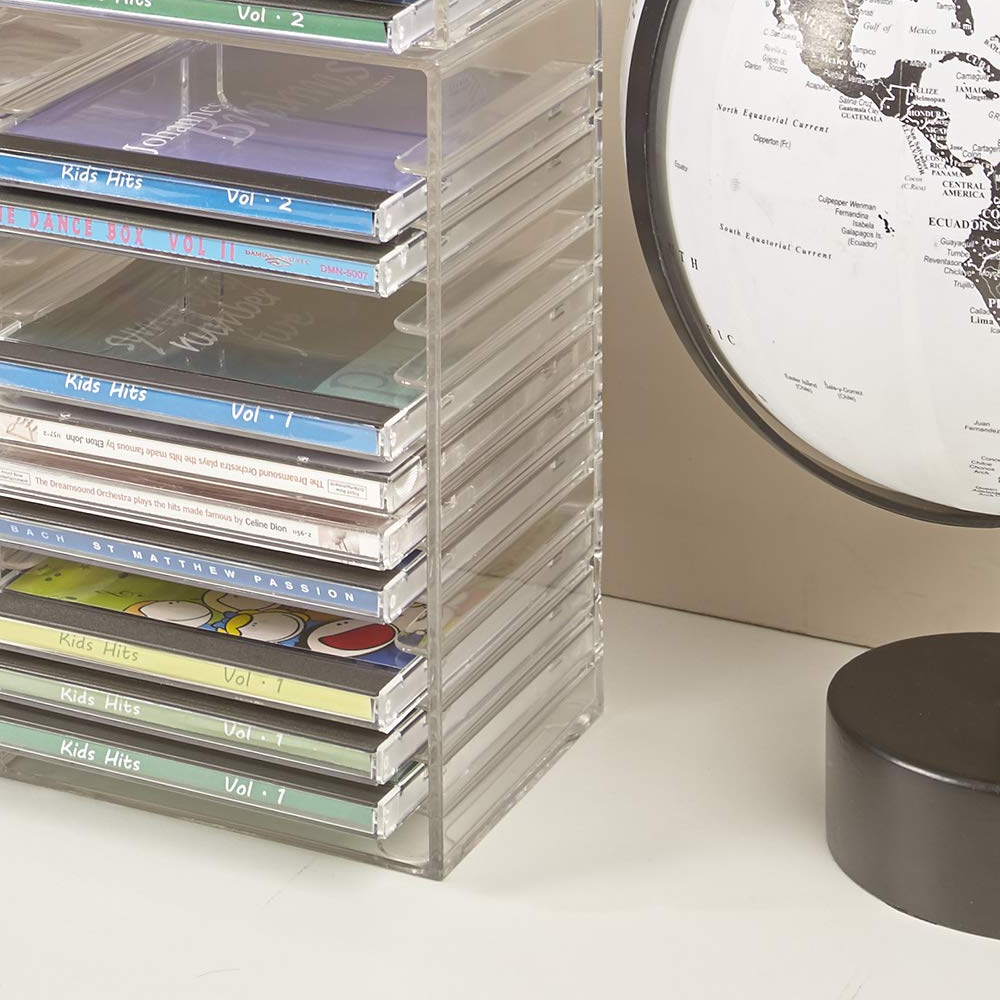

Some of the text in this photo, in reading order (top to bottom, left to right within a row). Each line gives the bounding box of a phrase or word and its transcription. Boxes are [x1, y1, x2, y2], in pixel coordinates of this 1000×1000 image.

[237, 5, 266, 24] Vol
[291, 11, 305, 28] 2
[862, 22, 937, 36] Gulf of Mexico
[716, 103, 830, 135] North Equatorial Current
[62, 164, 293, 213] Kids Hits Vol 2
[942, 179, 986, 191] CENTRAL
[942, 189, 986, 200] AMERICA
[928, 216, 988, 232] ECUADOR
[29, 210, 92, 237] DANCE
[108, 222, 145, 246] BOX
[168, 232, 206, 257] VOL
[320, 264, 369, 280] DMN-5007
[719, 223, 833, 261] South Equatorial Current
[970, 316, 994, 326] Lima
[65, 372, 294, 429] Kids Hits Vol 1
[10, 523, 356, 602] BACH ST MATTHEW PASSION
[60, 740, 286, 805] Kids Hits Vol 1
